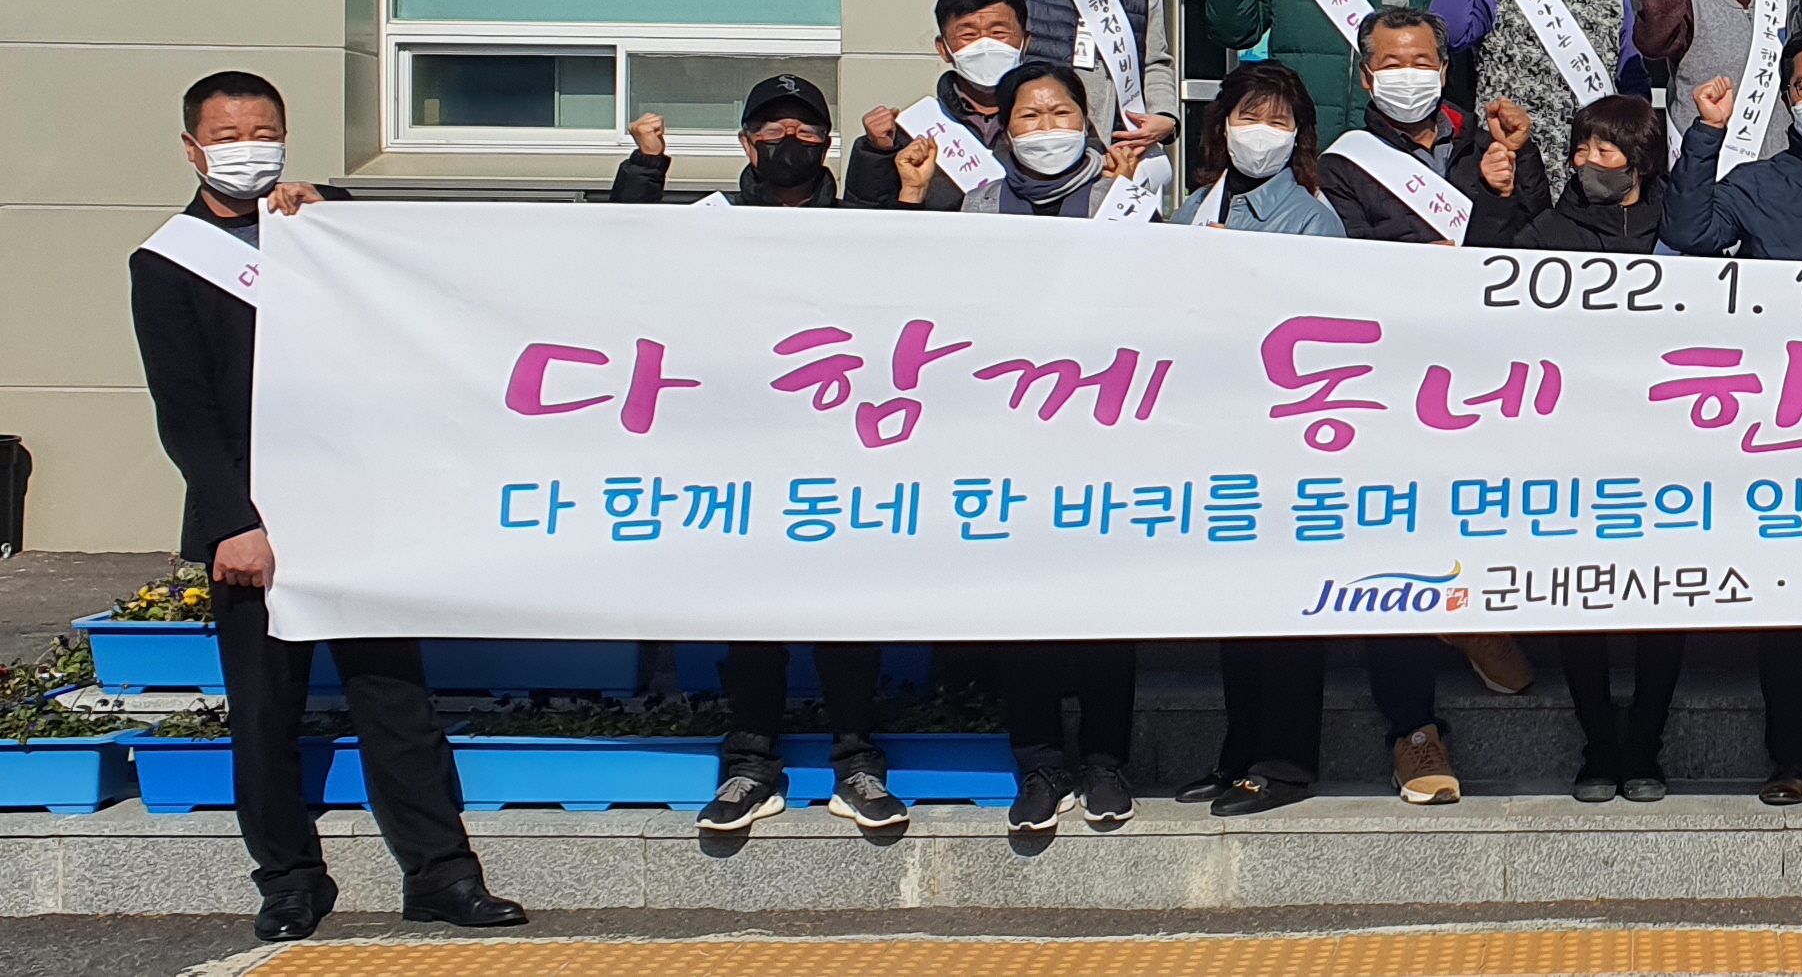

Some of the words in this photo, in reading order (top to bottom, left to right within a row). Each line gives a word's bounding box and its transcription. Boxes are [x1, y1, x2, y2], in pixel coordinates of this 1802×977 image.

[1569, 52, 1607, 97] 행정
[1735, 48, 1778, 142] 행정서비스
[1405, 174, 1426, 194] 다
[1429, 191, 1469, 228] 함께
[1484, 255, 1685, 311] 2022.
[1718, 262, 1764, 314] 1.
[505, 338, 701, 434] 다
[770, 320, 1173, 448] 함께
[1261, 316, 1561, 452] 동네
[500, 480, 576, 534] 다
[603, 477, 751, 541] 함께
[783, 478, 920, 542] 동네
[952, 478, 1027, 540] 한
[1054, 474, 1262, 542] 바퀴를
[1291, 478, 1417, 541] 돌며
[1451, 478, 1712, 539] 면민들의
[1302, 579, 1441, 616] Jindo
[1482, 563, 1753, 611] 군내면사무소
